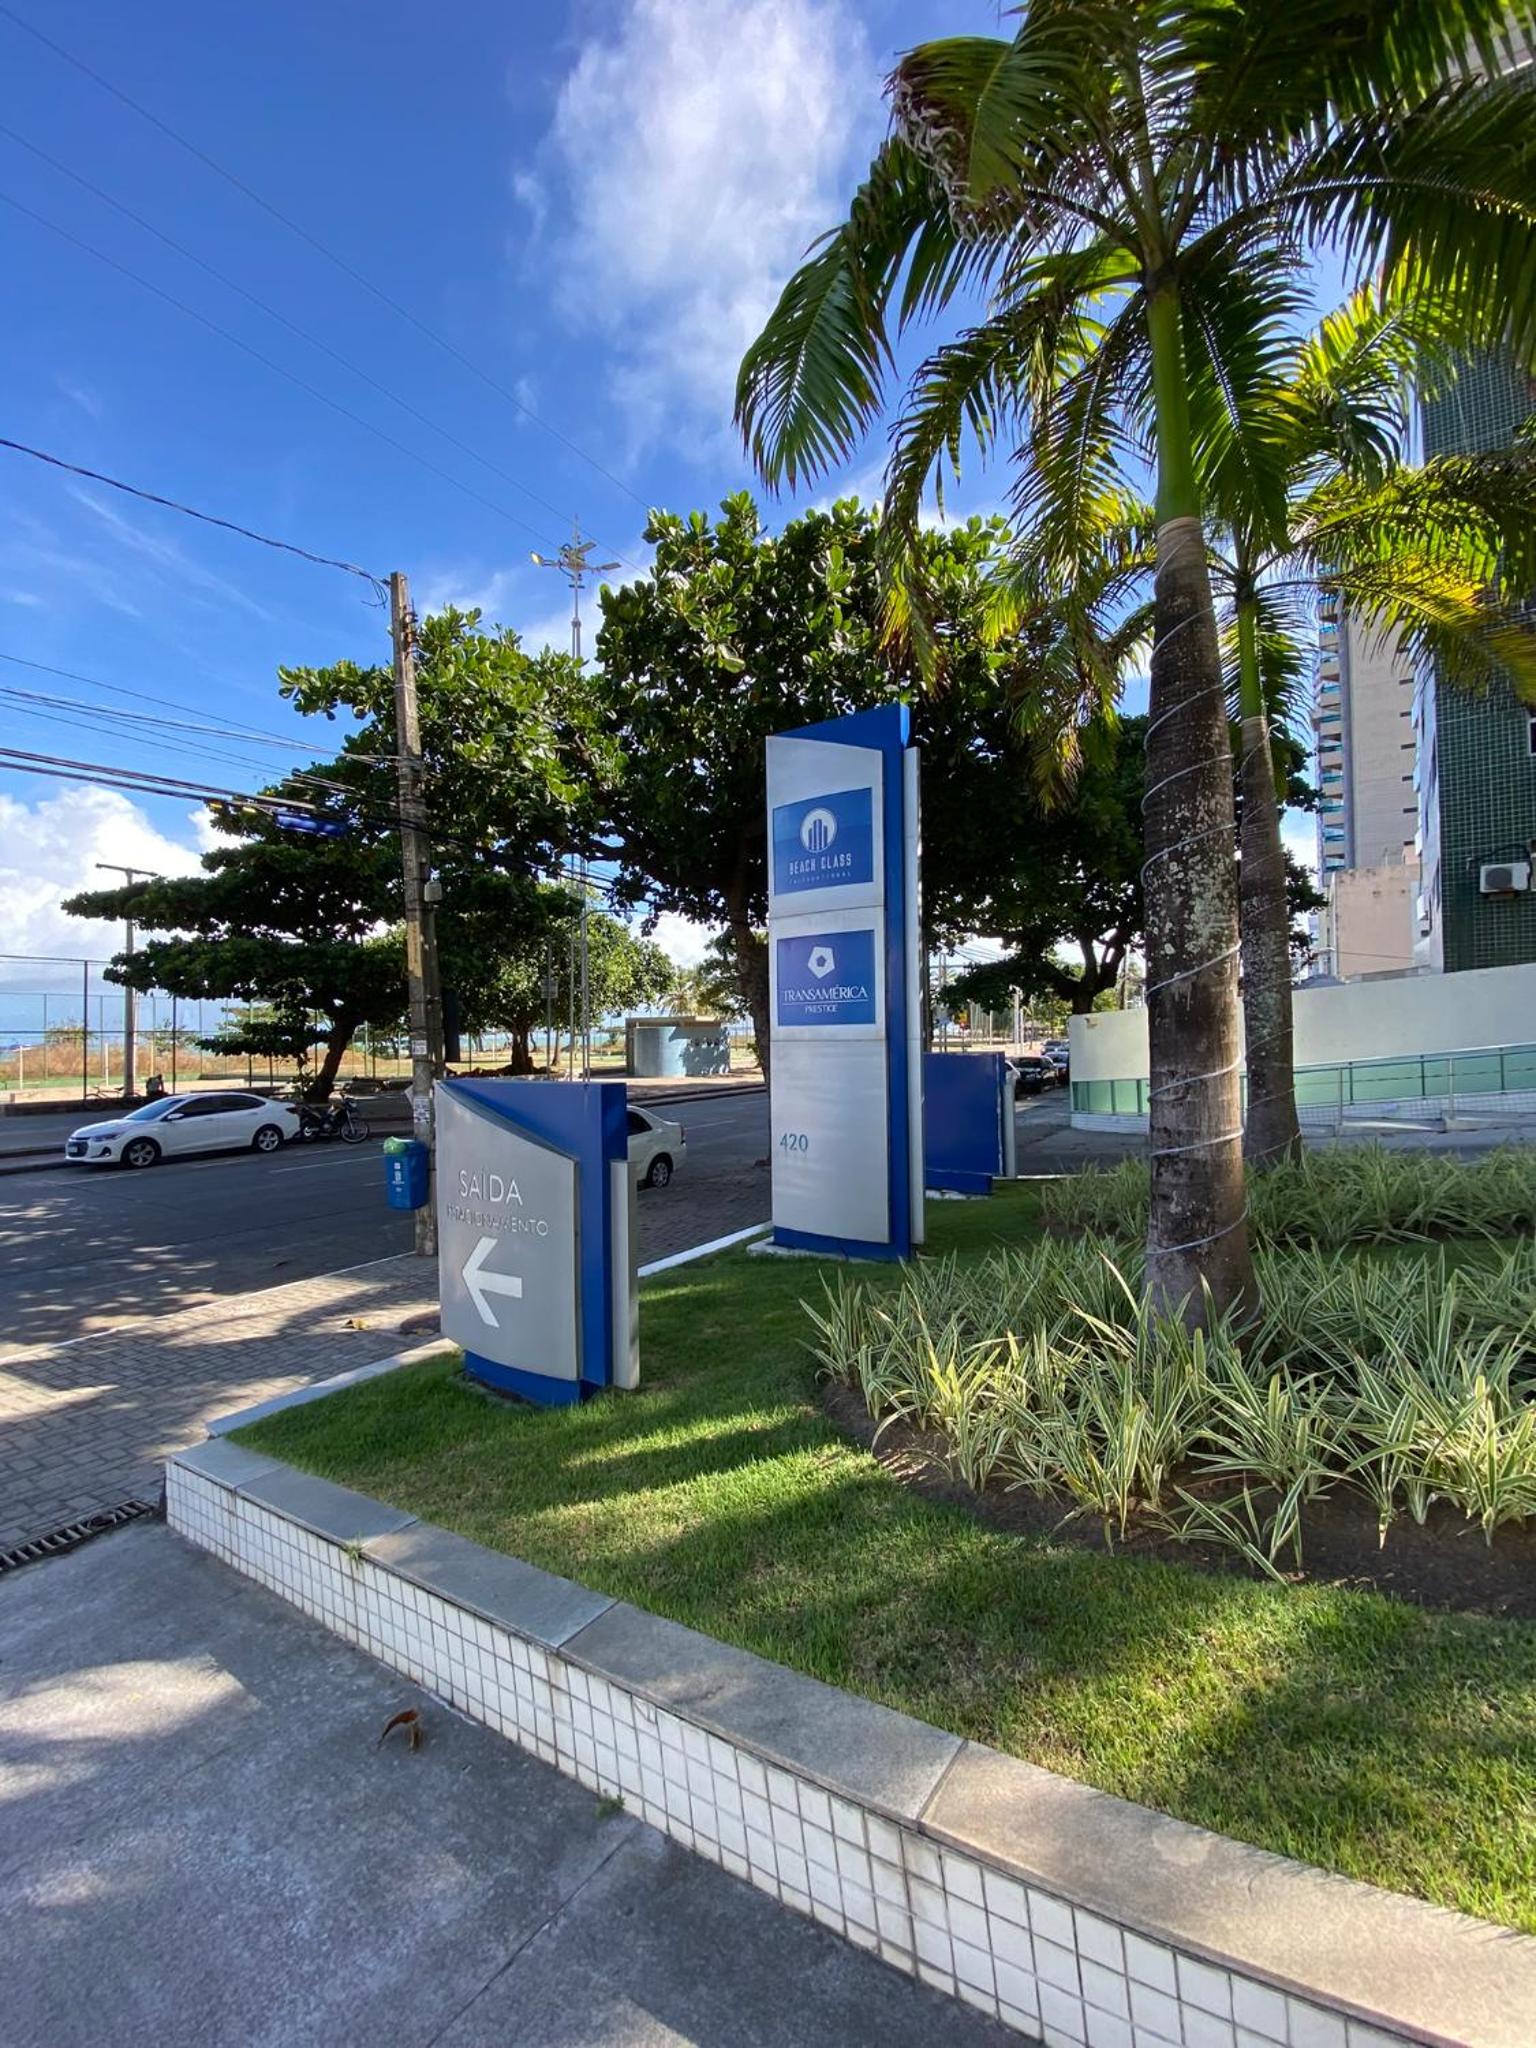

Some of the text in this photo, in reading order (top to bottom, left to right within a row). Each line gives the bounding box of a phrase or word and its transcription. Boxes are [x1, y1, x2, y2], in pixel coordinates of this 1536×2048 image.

[789, 853, 852, 876] BEACH CLASS
[805, 1004, 838, 1014] PRESTIGE
[779, 1133, 809, 1152] 420
